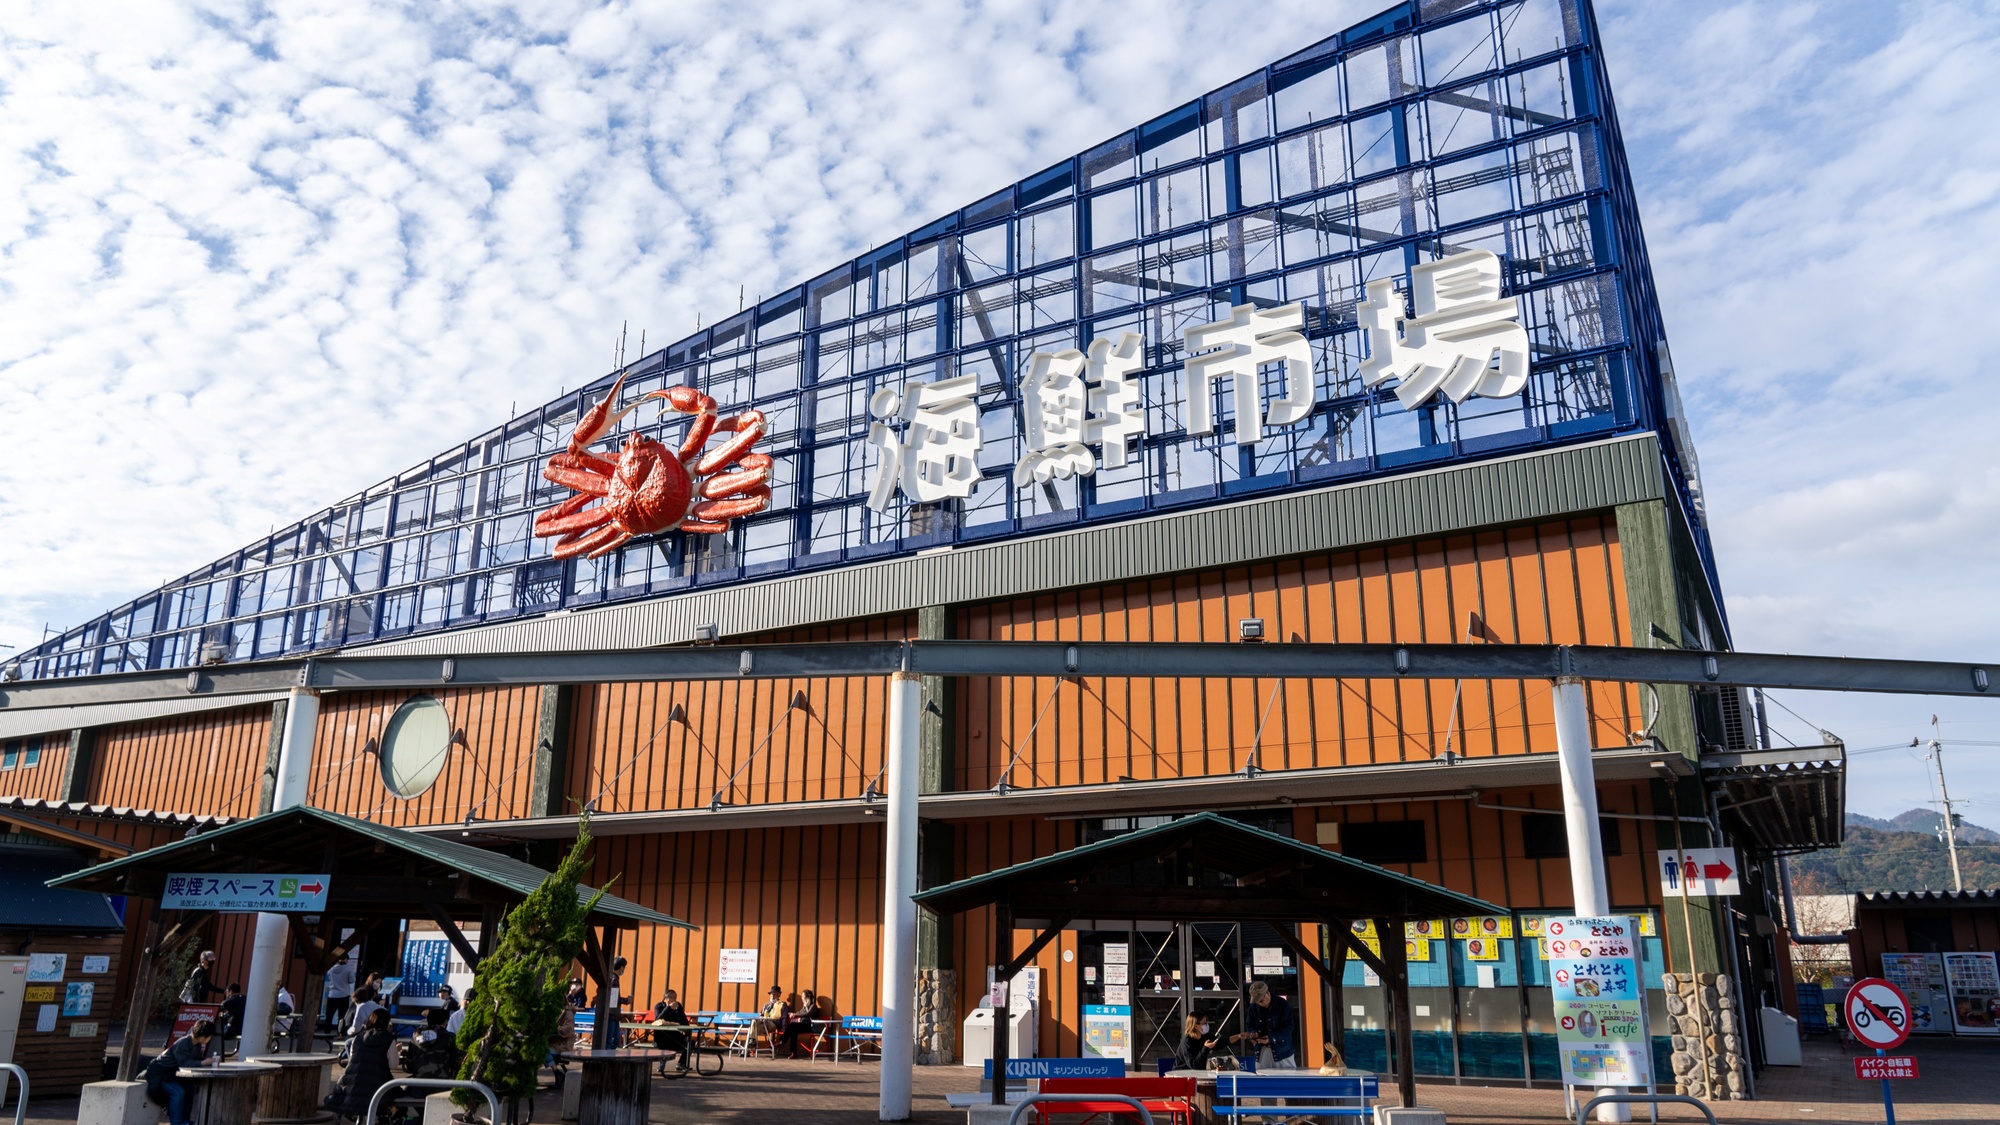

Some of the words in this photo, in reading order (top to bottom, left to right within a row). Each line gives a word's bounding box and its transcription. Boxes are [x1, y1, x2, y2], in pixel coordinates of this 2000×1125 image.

[866, 248, 1531, 512] 海鮮市場
[167, 877, 275, 897] 喫煙スペース
[1591, 925, 1624, 936] ととや
[1599, 946, 1628, 956] ととや
[1573, 963, 1626, 976] とれとれ
[1602, 979, 1628, 993] 寿司
[851, 1018, 875, 1028] KIRIN
[1600, 1019, 1638, 1037] i-café
[1005, 1062, 1049, 1076] KIRIN
[1053, 1066, 1108, 1075] キリンビバレッジ
[1861, 1058, 1912, 1067] バイク・自転車
[1862, 1068, 1914, 1078] 乗り入れ禁止
